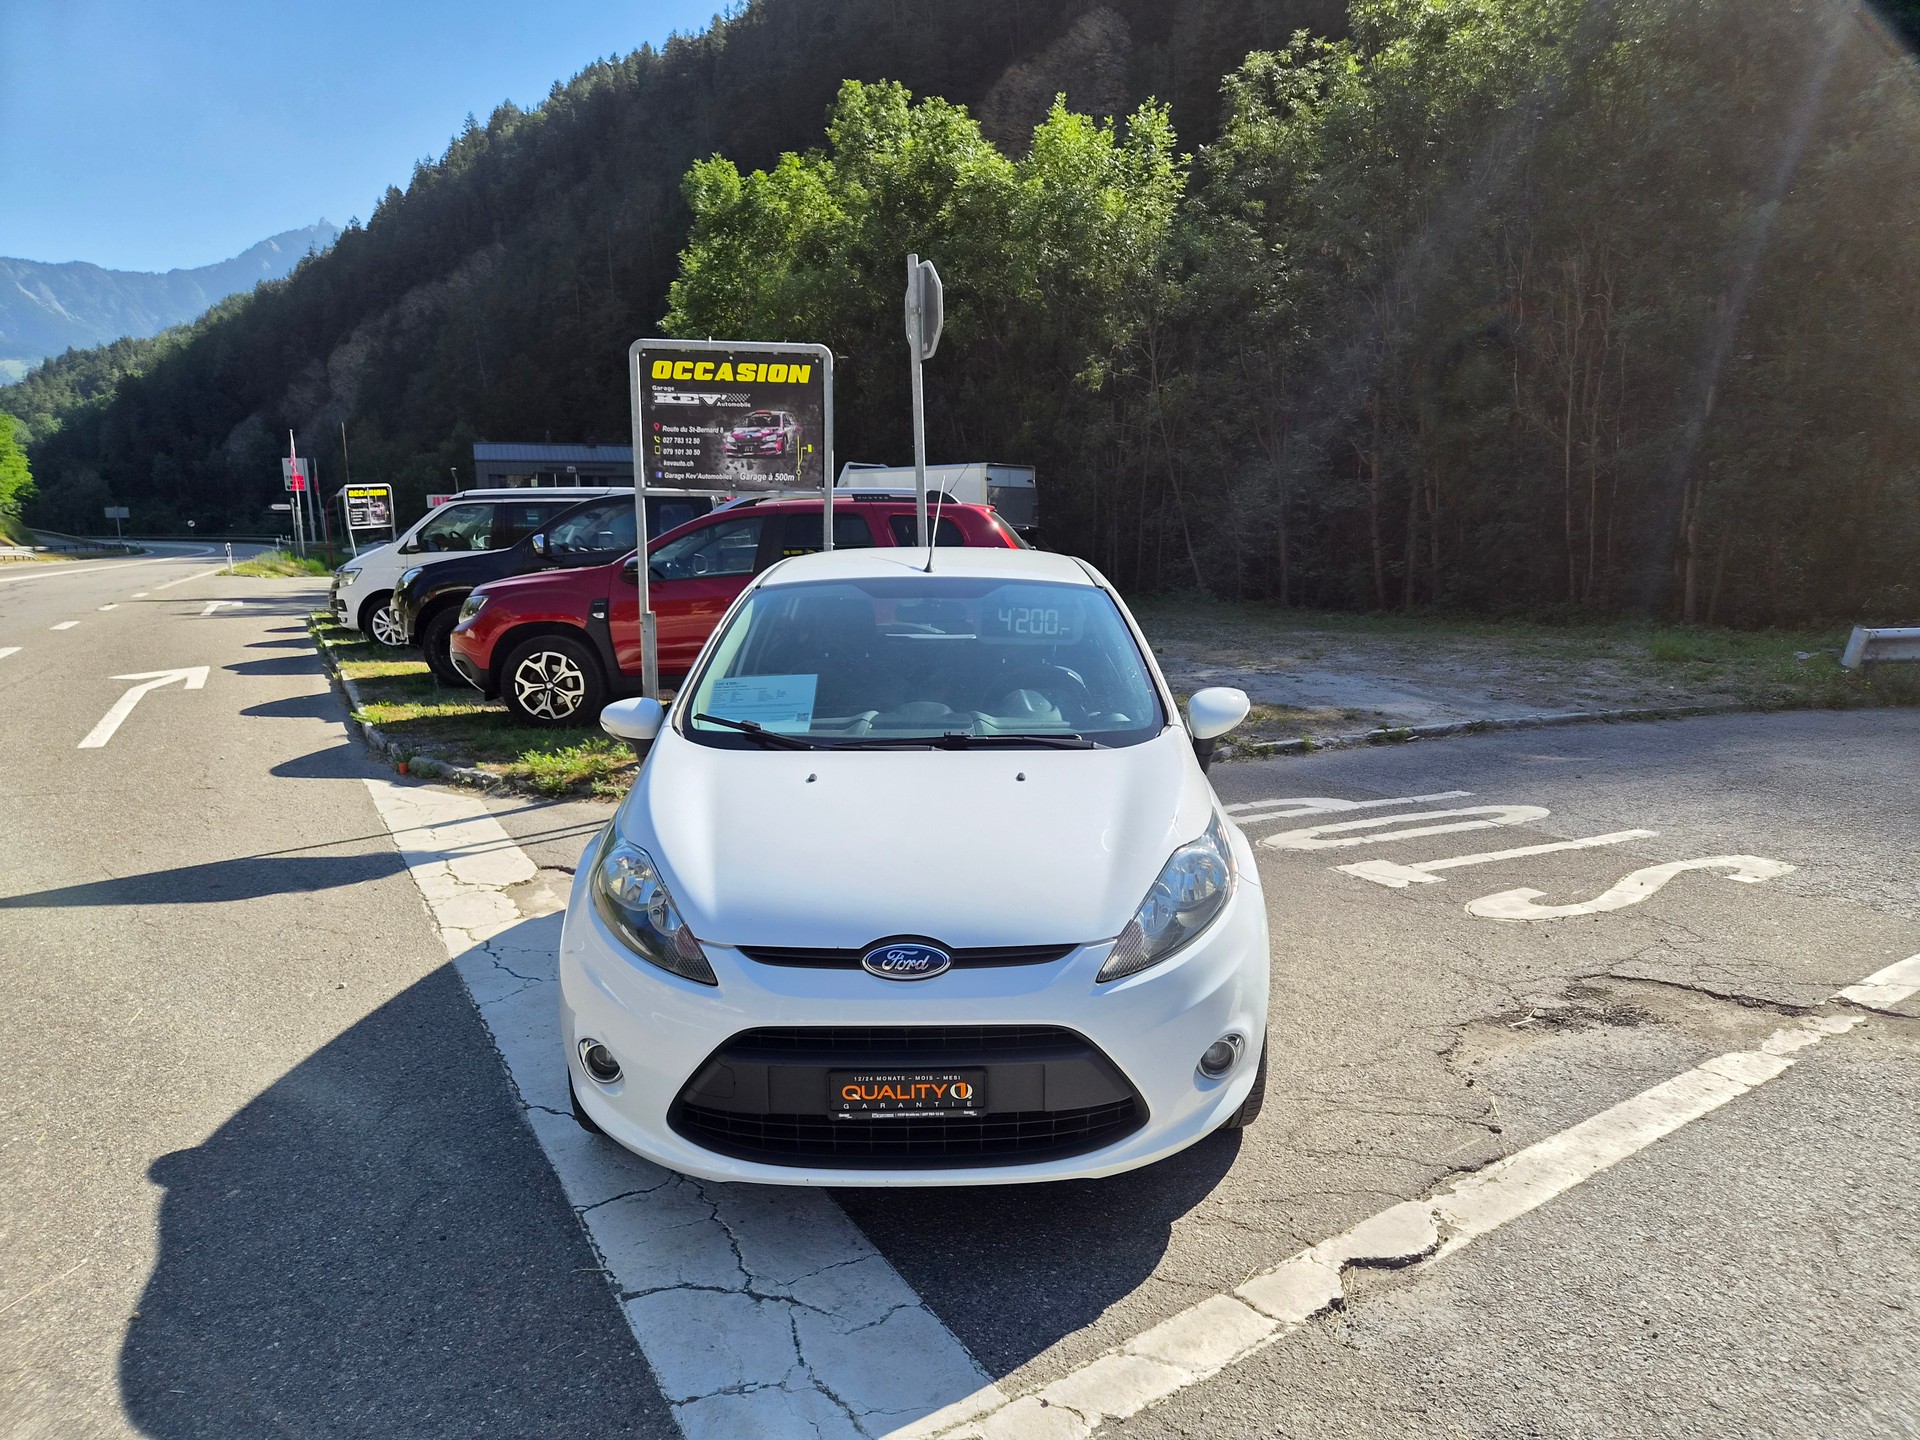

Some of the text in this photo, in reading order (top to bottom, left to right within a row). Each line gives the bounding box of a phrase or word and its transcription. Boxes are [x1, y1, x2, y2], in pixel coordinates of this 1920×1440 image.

[651, 360, 812, 384] OCCASION
[652, 384, 675, 392] Garage
[662, 425, 680, 433] Route
[689, 426, 719, 434] St-Bernard
[692, 437, 701, 445] 50
[664, 472, 685, 481] Garage
[740, 472, 795, 482] Garage à 500m
[881, 949, 931, 971] Ford
[841, 1084, 948, 1100] QUALITY
[843, 1101, 972, 1109] GARANTIE
